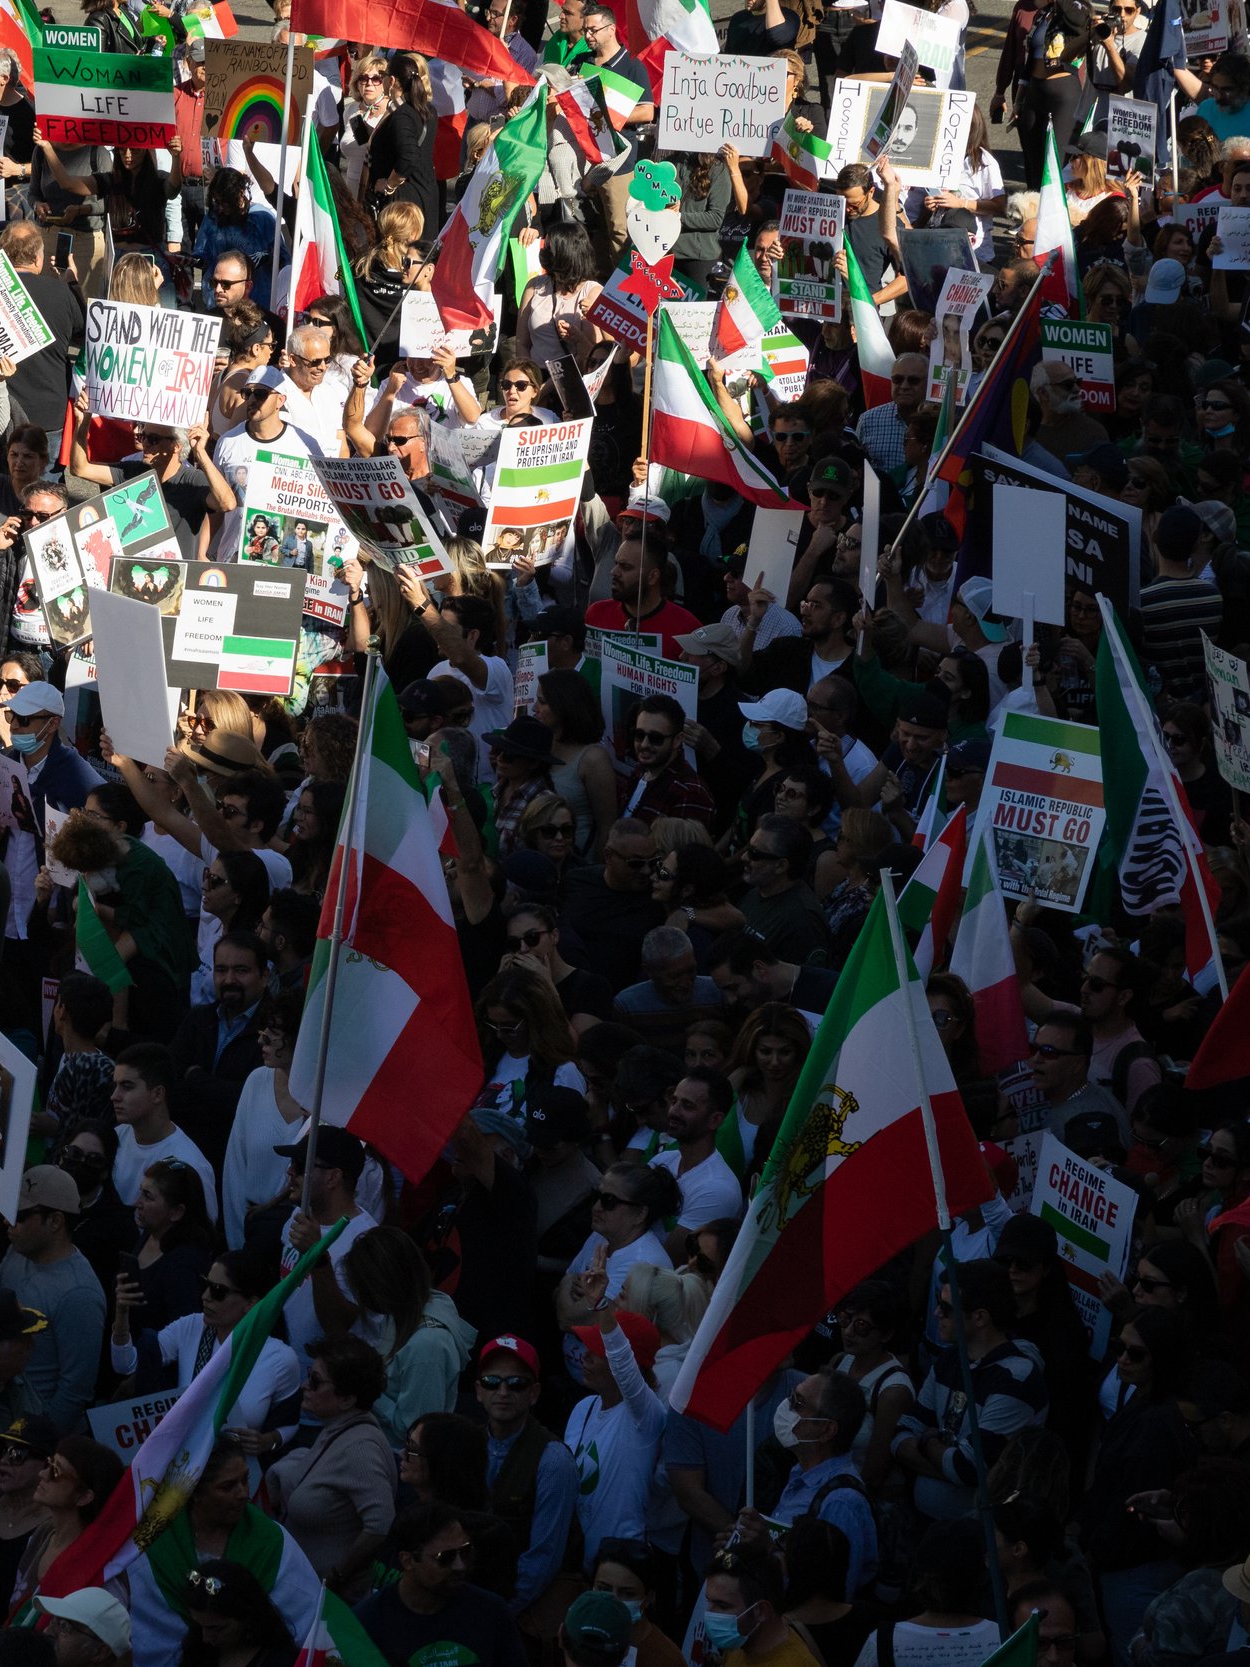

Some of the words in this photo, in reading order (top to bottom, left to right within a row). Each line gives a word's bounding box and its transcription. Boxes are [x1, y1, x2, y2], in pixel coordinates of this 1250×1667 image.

[45, 29, 97, 49] WOMEN
[47, 55, 141, 80] WOMAN
[228, 57, 281, 75] RAINBOW
[670, 65, 708, 101] Inja
[714, 71, 780, 105] Goodbye
[81, 93, 129, 115] LIFE
[1113, 107, 1137, 119] WOMEN
[1138, 113, 1152, 123] LIFE
[46, 118, 167, 145] FREEDOM
[666, 105, 714, 140] Partye
[720, 108, 780, 141] Rahbare
[1112, 115, 1152, 132] FREEDOM
[637, 164, 678, 204] WOMAN
[786, 204, 808, 215] ISLAMIC
[809, 207, 837, 219] REPUBLIC
[808, 197, 841, 209] AYATOLLAHS
[635, 213, 669, 251] LIFE
[783, 213, 814, 233] MUST
[815, 217, 836, 238] GO
[631, 254, 679, 297] FREEDOM
[791, 281, 827, 297] STAND
[946, 284, 982, 304] CHANGE
[793, 300, 823, 315] IRAN
[87, 301, 142, 345] STAND
[190, 316, 219, 354] THE
[1045, 325, 1108, 347] WOMEN
[86, 342, 158, 388] WOMEN
[166, 350, 216, 398] IRAN
[518, 423, 584, 447] SUPPORT
[516, 447, 529, 458] THE
[531, 441, 562, 455] UPRISING
[565, 438, 578, 450] AND
[516, 454, 548, 469] PROTEST
[558, 447, 574, 461] IRAN
[347, 460, 396, 471] AYATOLLAHS
[353, 471, 397, 482] REPUBLIC
[271, 475, 303, 494] Media
[381, 481, 406, 500] GO
[277, 492, 334, 515] SUPPORTS
[1067, 503, 1120, 539] NAME
[309, 574, 328, 589] Kian
[193, 598, 224, 607] WOMEN
[197, 615, 214, 624] LIFE
[184, 632, 223, 642] FREEDOM
[654, 660, 696, 684] Freedom.
[999, 790, 1046, 811] ISLAMIC
[1047, 799, 1094, 820] REPUBLIC
[994, 802, 1060, 837] MUST
[1062, 816, 1091, 844] GO
[1003, 880, 1022, 895] with
[532, 1107, 546, 1121] alo
[1064, 1157, 1106, 1195] REGIME
[1049, 1163, 1119, 1230] CHANGE
[1057, 1196, 1069, 1211] in
[1069, 1203, 1099, 1233] IRAN
